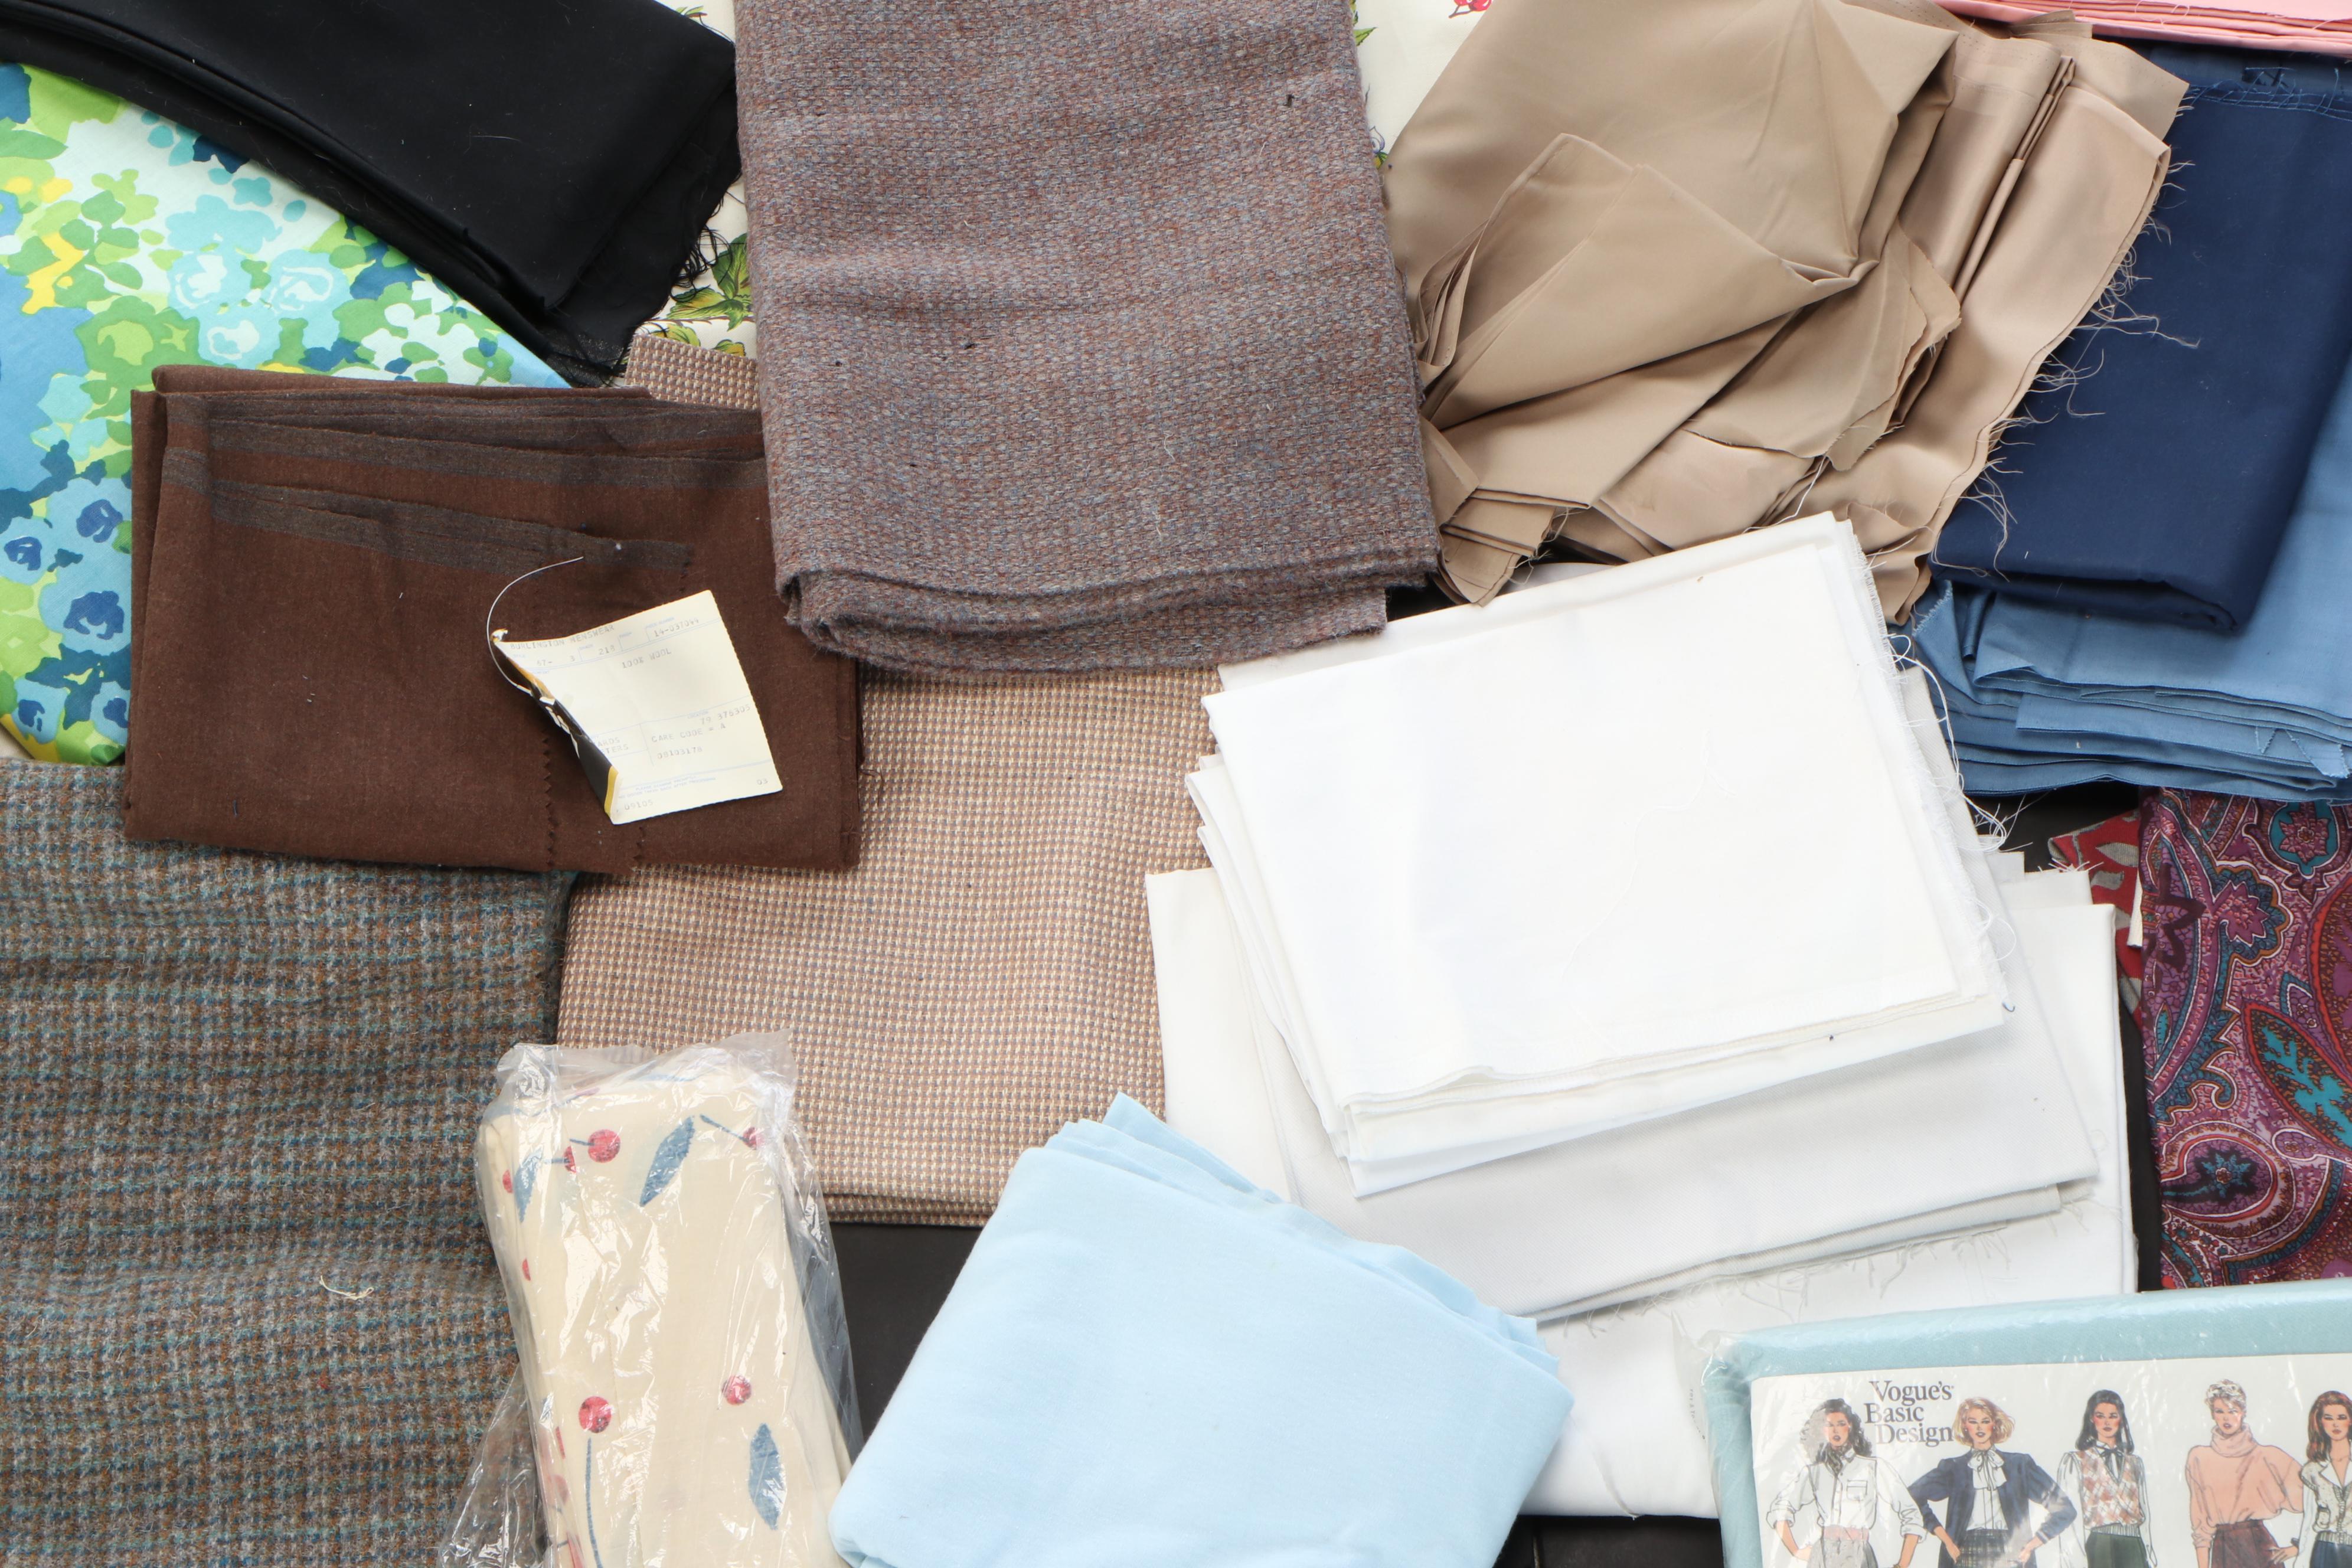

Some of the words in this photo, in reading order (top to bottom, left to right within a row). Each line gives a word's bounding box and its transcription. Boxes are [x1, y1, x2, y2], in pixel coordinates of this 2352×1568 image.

[510, 639, 565, 650] BURLINGTON
[570, 625, 615, 643] MENSWEAR
[622, 656, 645, 669] 100%
[649, 648, 672, 661] WOOL
[596, 736, 620, 747] ARDS
[651, 734, 674, 743] CARE
[680, 727, 703, 739] CODE
[1868, 1380, 1953, 1406] Vogue's
[1864, 1402, 1925, 1424] Basic
[1873, 1423, 1954, 1447] Design
